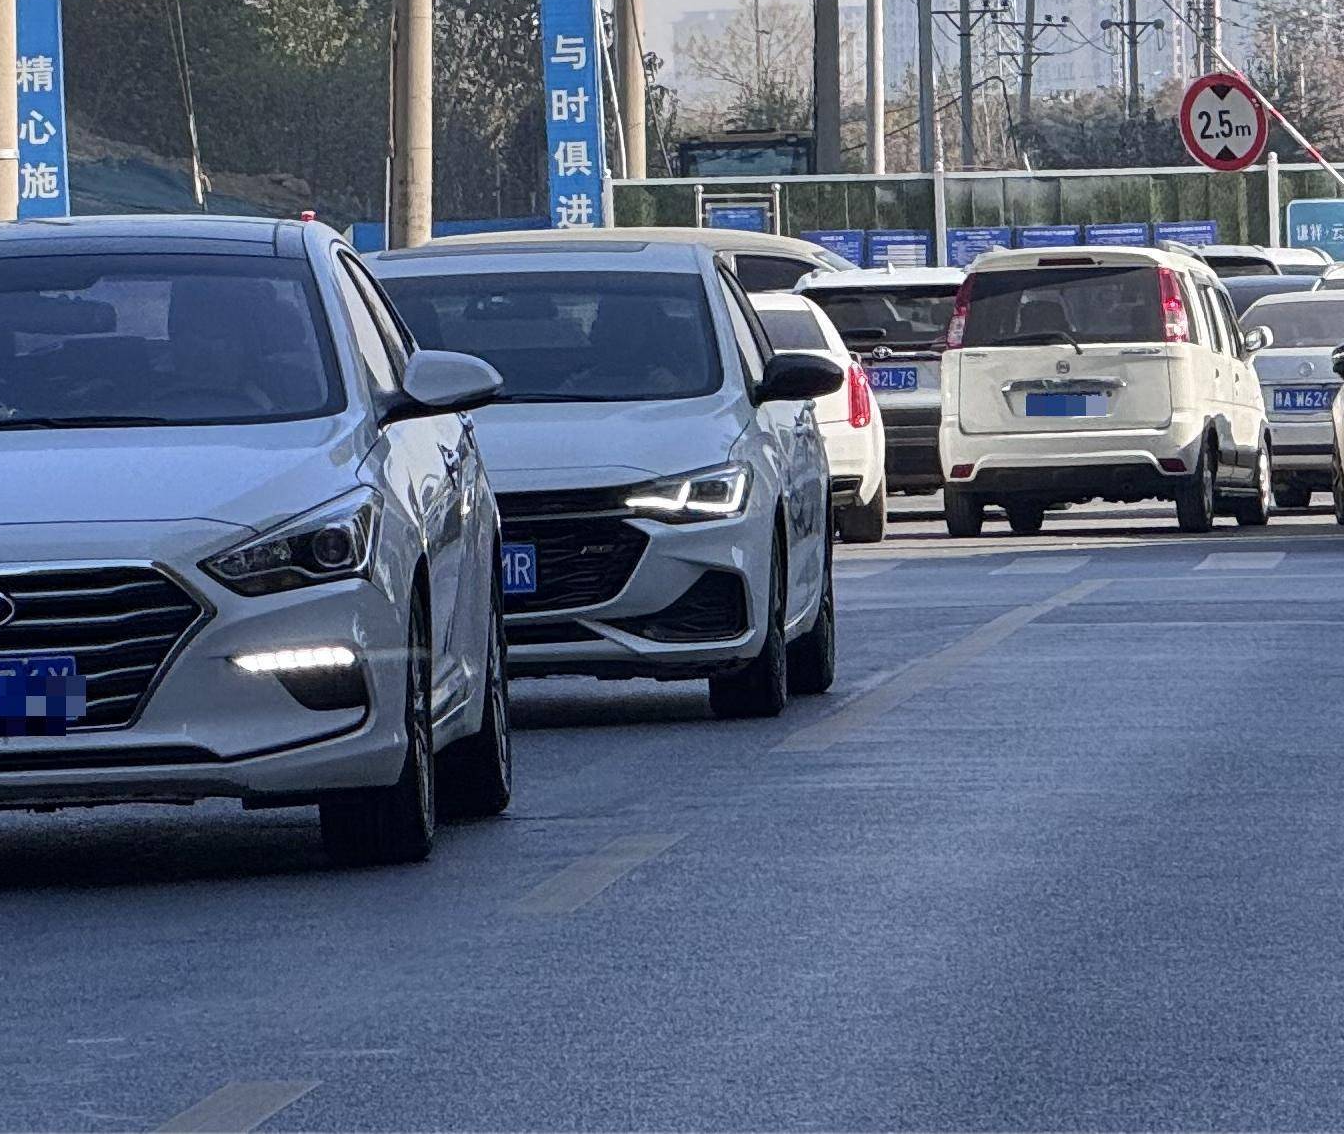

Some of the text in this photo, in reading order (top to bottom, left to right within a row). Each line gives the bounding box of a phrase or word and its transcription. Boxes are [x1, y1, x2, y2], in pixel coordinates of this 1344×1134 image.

[551, 34, 594, 229] 与时俱进
[1198, 109, 1252, 139] 2.5m
